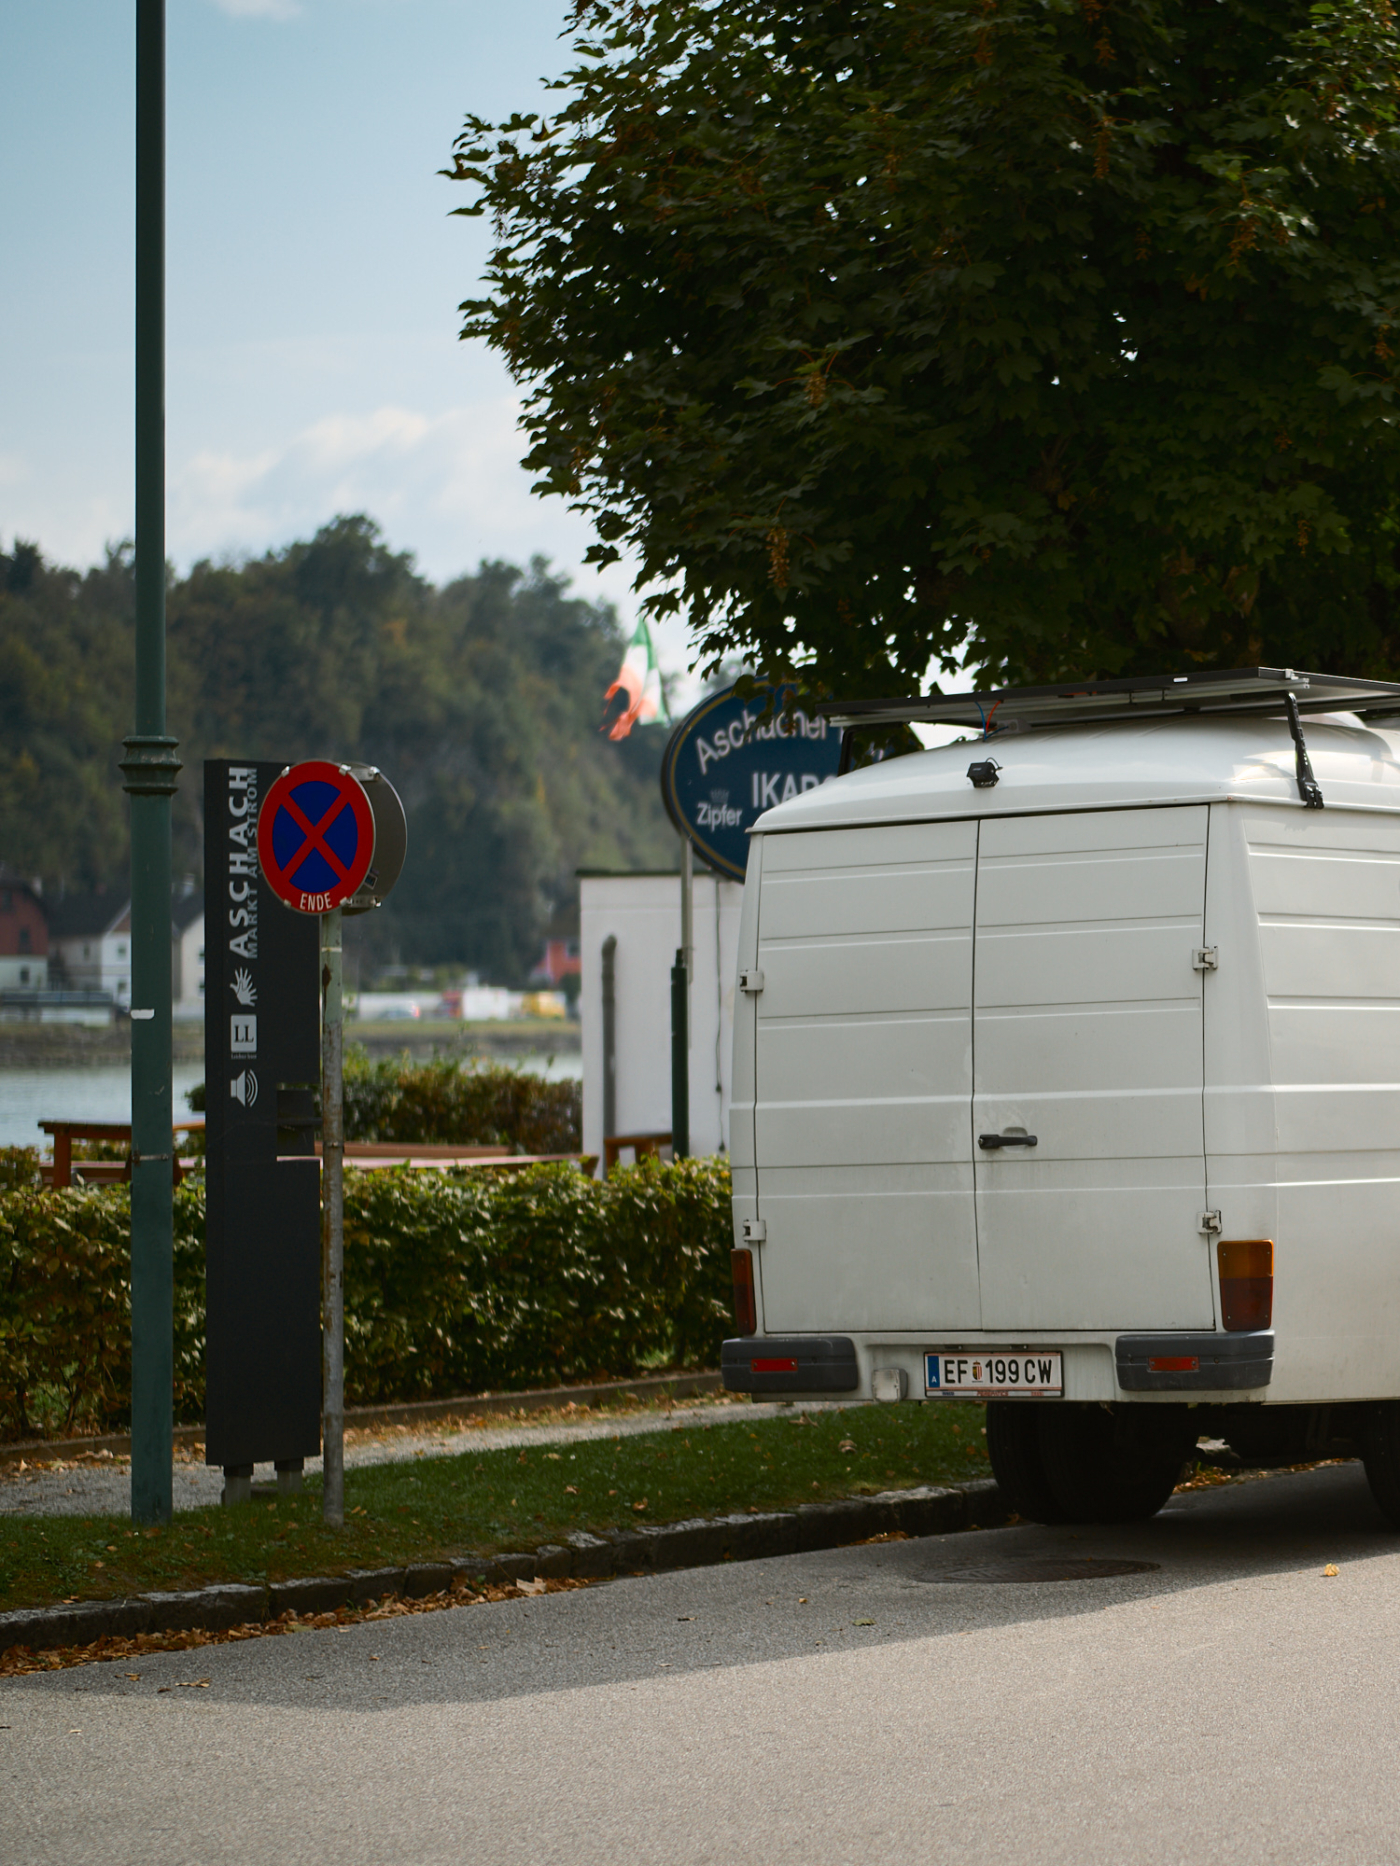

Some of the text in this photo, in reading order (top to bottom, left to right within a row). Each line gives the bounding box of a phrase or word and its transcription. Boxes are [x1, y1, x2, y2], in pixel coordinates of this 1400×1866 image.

[697, 802, 743, 832] Zipfer
[228, 766, 249, 959] ASCHACH
[246, 767, 258, 959] MARKT AM STROM
[300, 892, 333, 911] ENDE
[944, 1360, 968, 1384] EF
